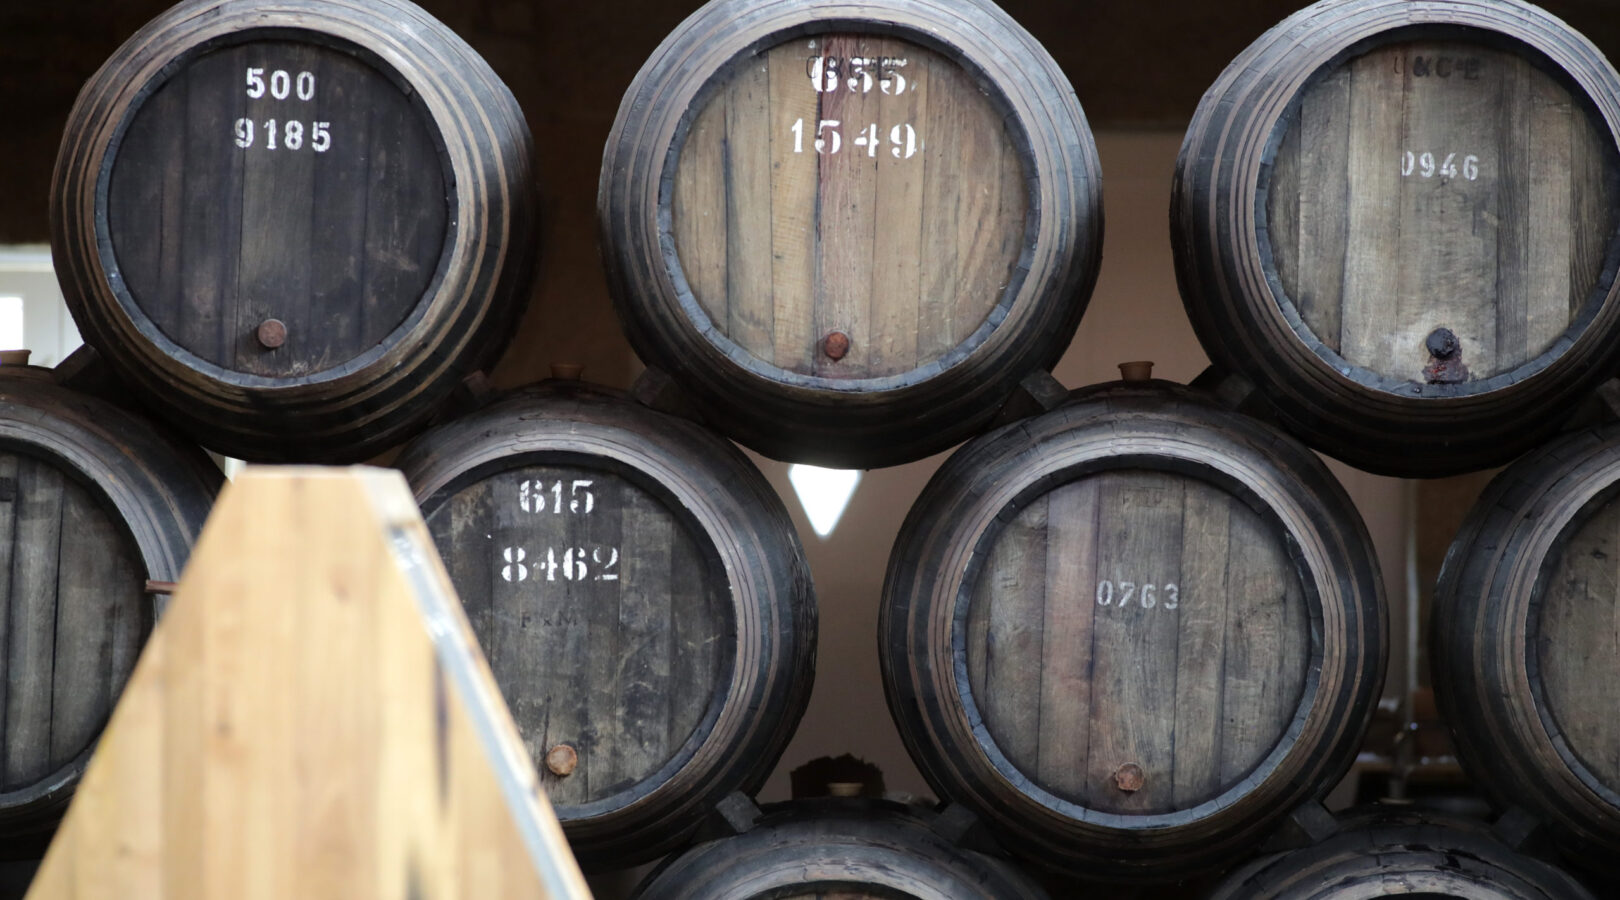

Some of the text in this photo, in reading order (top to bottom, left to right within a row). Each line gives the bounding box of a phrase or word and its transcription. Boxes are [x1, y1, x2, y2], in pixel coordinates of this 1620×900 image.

[246, 67, 315, 101] 500
[234, 117, 331, 152] 9185
[791, 117, 918, 159] 1549
[1401, 150, 1479, 181] 0946
[519, 479, 594, 514] 615
[501, 546, 619, 582] 8462
[1097, 580, 1179, 610] 0763
